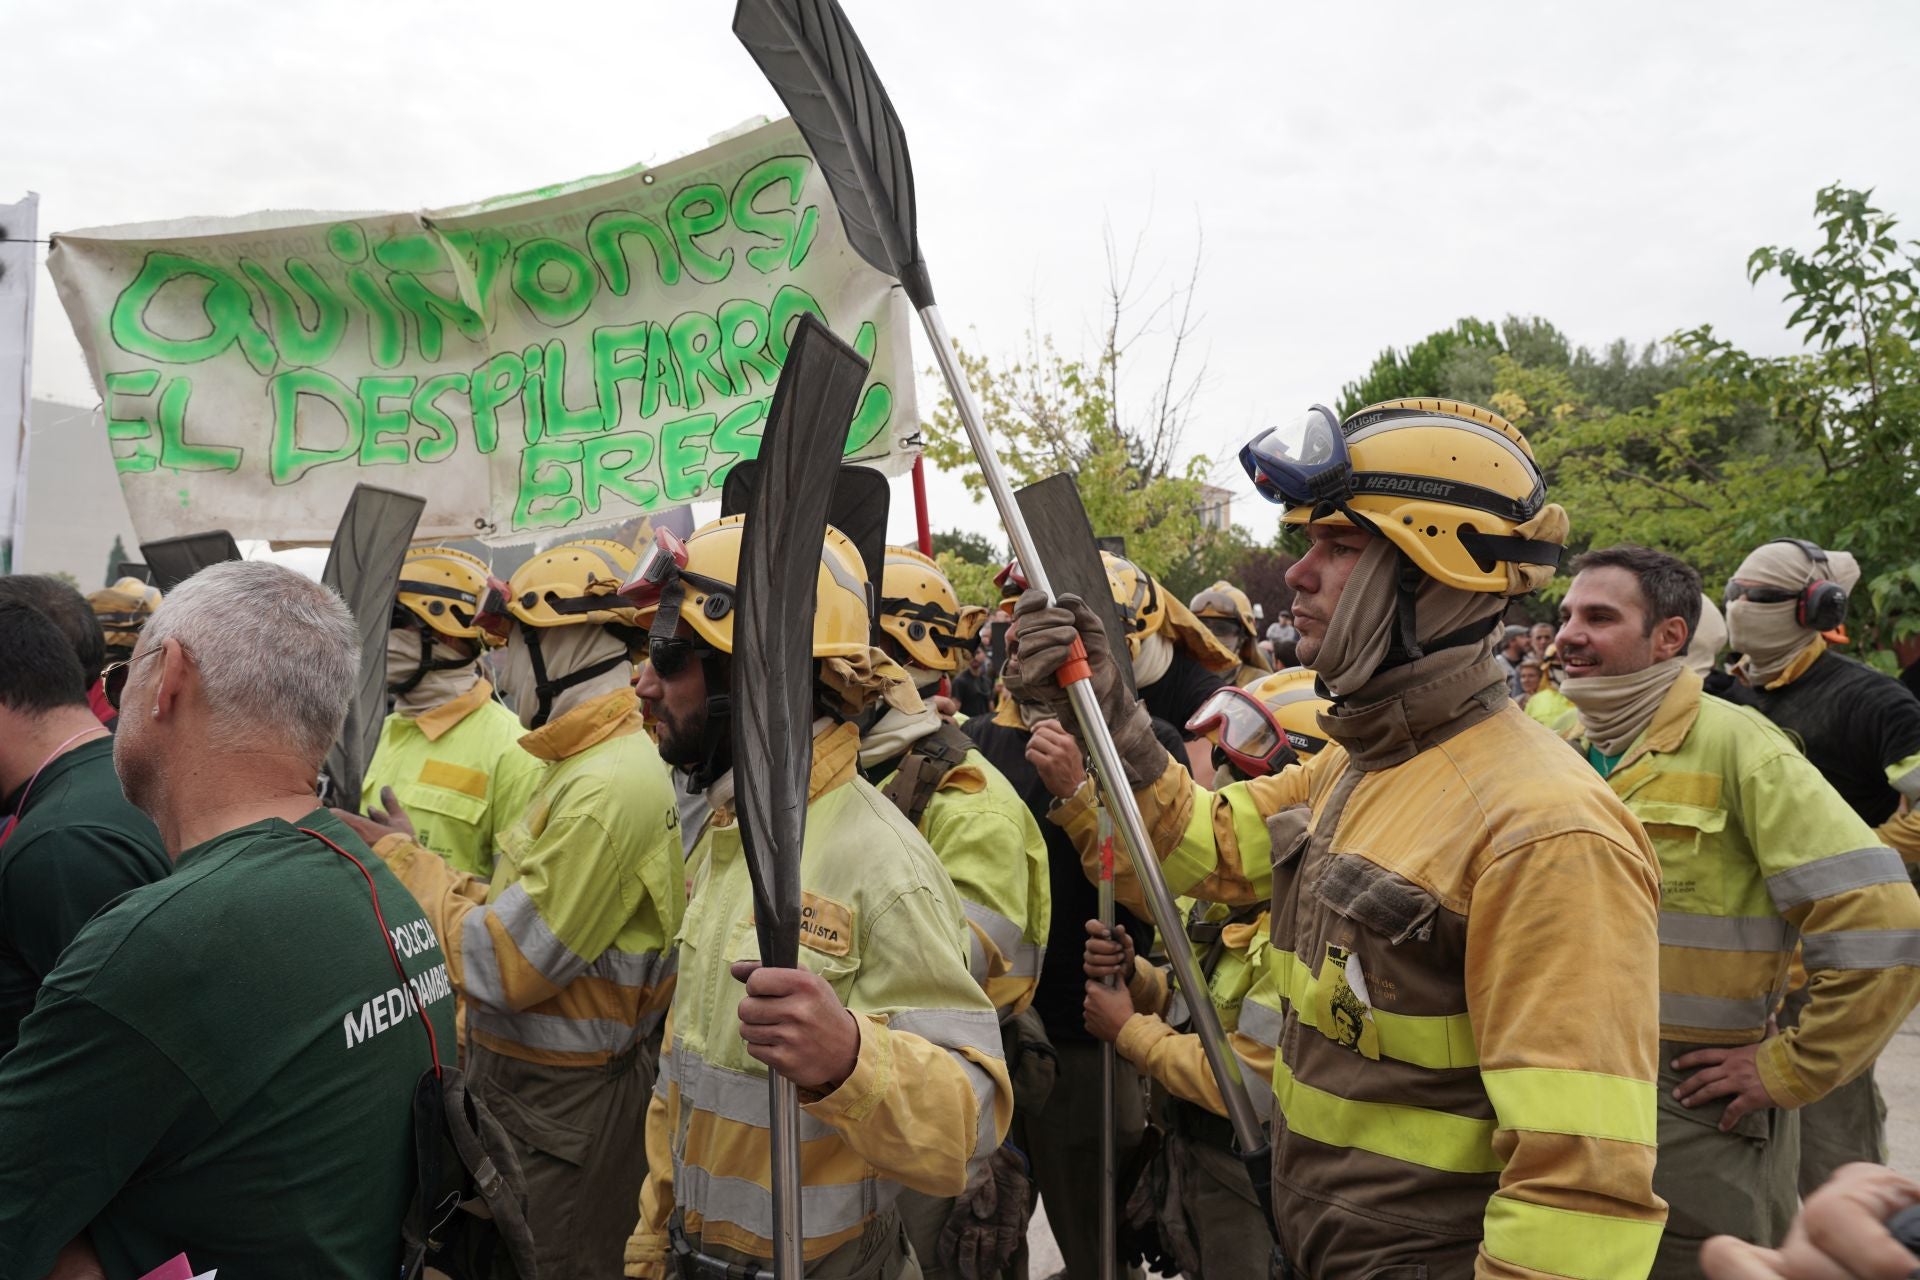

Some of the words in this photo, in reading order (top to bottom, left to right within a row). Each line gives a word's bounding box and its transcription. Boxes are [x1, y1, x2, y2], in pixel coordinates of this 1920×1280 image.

[106, 369, 244, 474] EL
[1341, 413, 1383, 435] ADLIGHT
[512, 400, 763, 532] ERES
[1365, 476, 1456, 497] HEADLIGHT
[1286, 733, 1308, 747] PETZL
[800, 920, 838, 942] ALISTA
[343, 963, 452, 1049] MEDIOAMBIE
